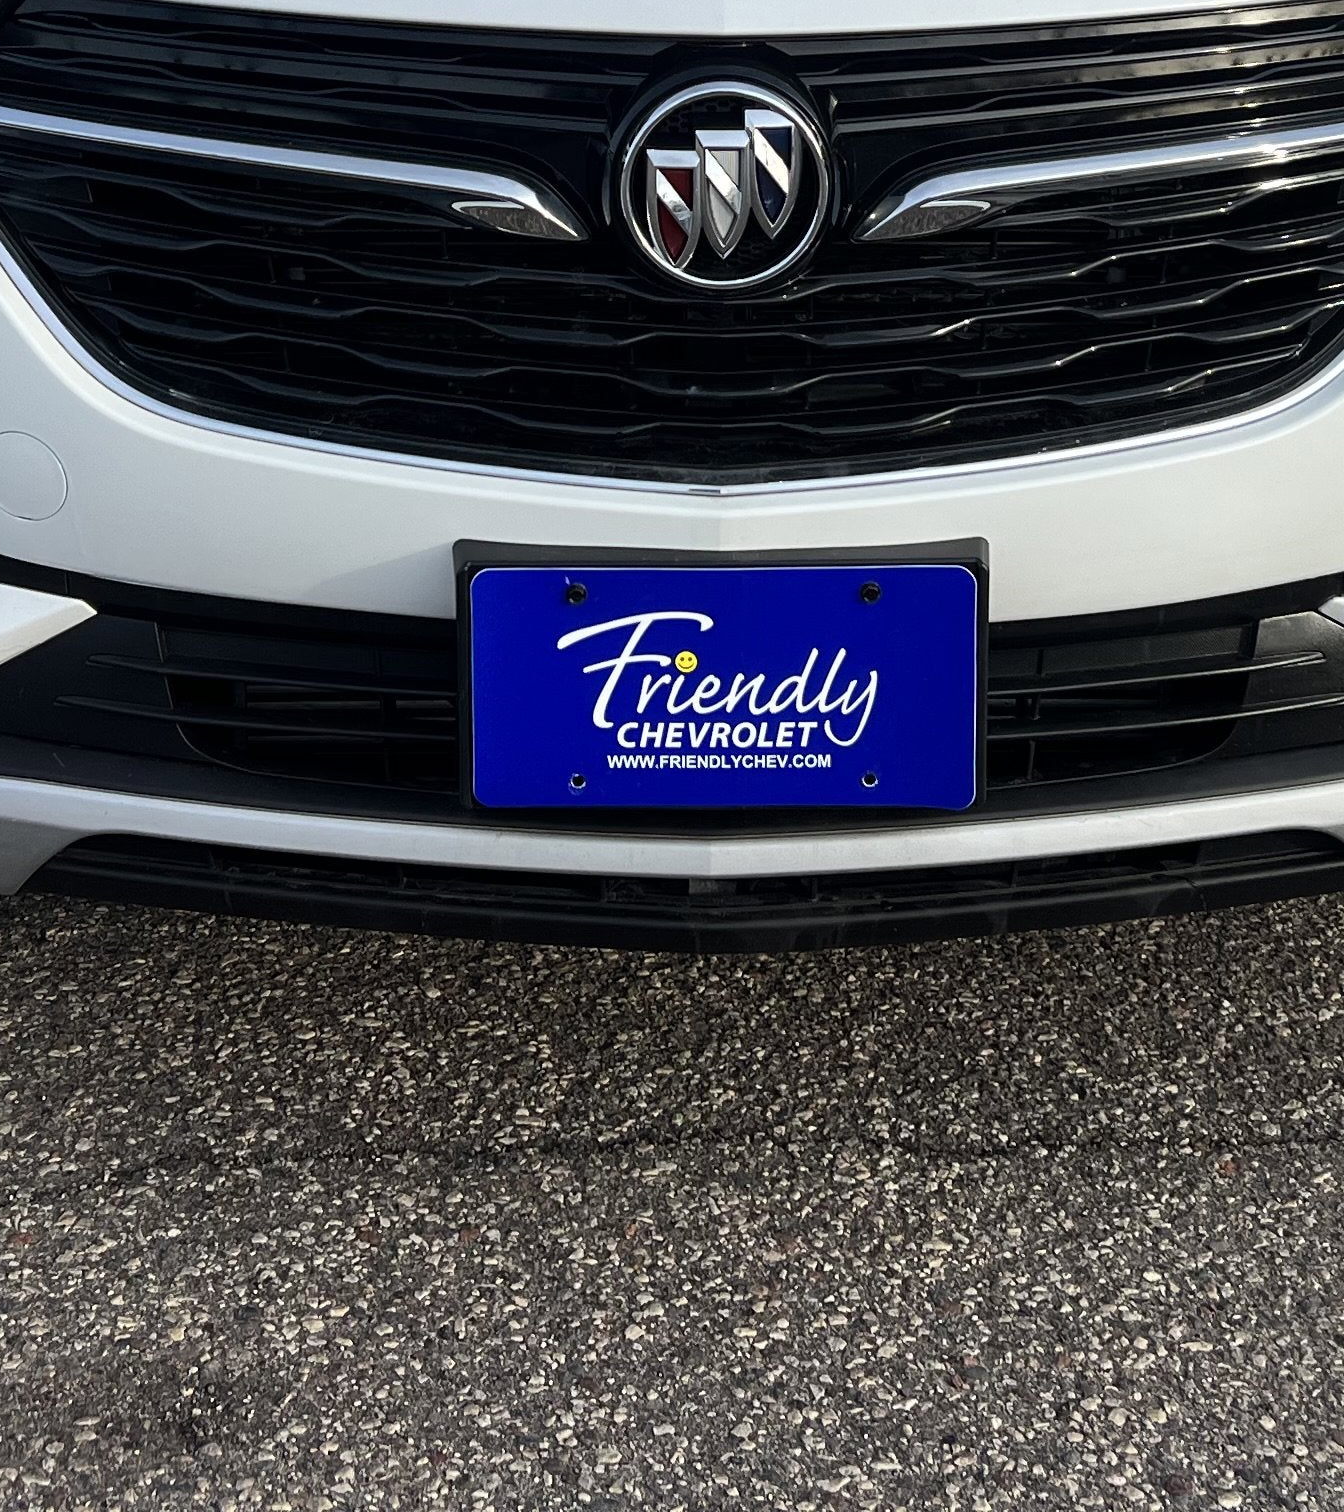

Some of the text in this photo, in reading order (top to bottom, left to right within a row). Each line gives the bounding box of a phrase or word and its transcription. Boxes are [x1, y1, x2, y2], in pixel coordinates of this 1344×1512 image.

[557, 611, 878, 747] Friendly
[616, 721, 819, 749] CHEVROLET
[607, 754, 832, 769] WWW.FRIENDLYCHEV.COM
